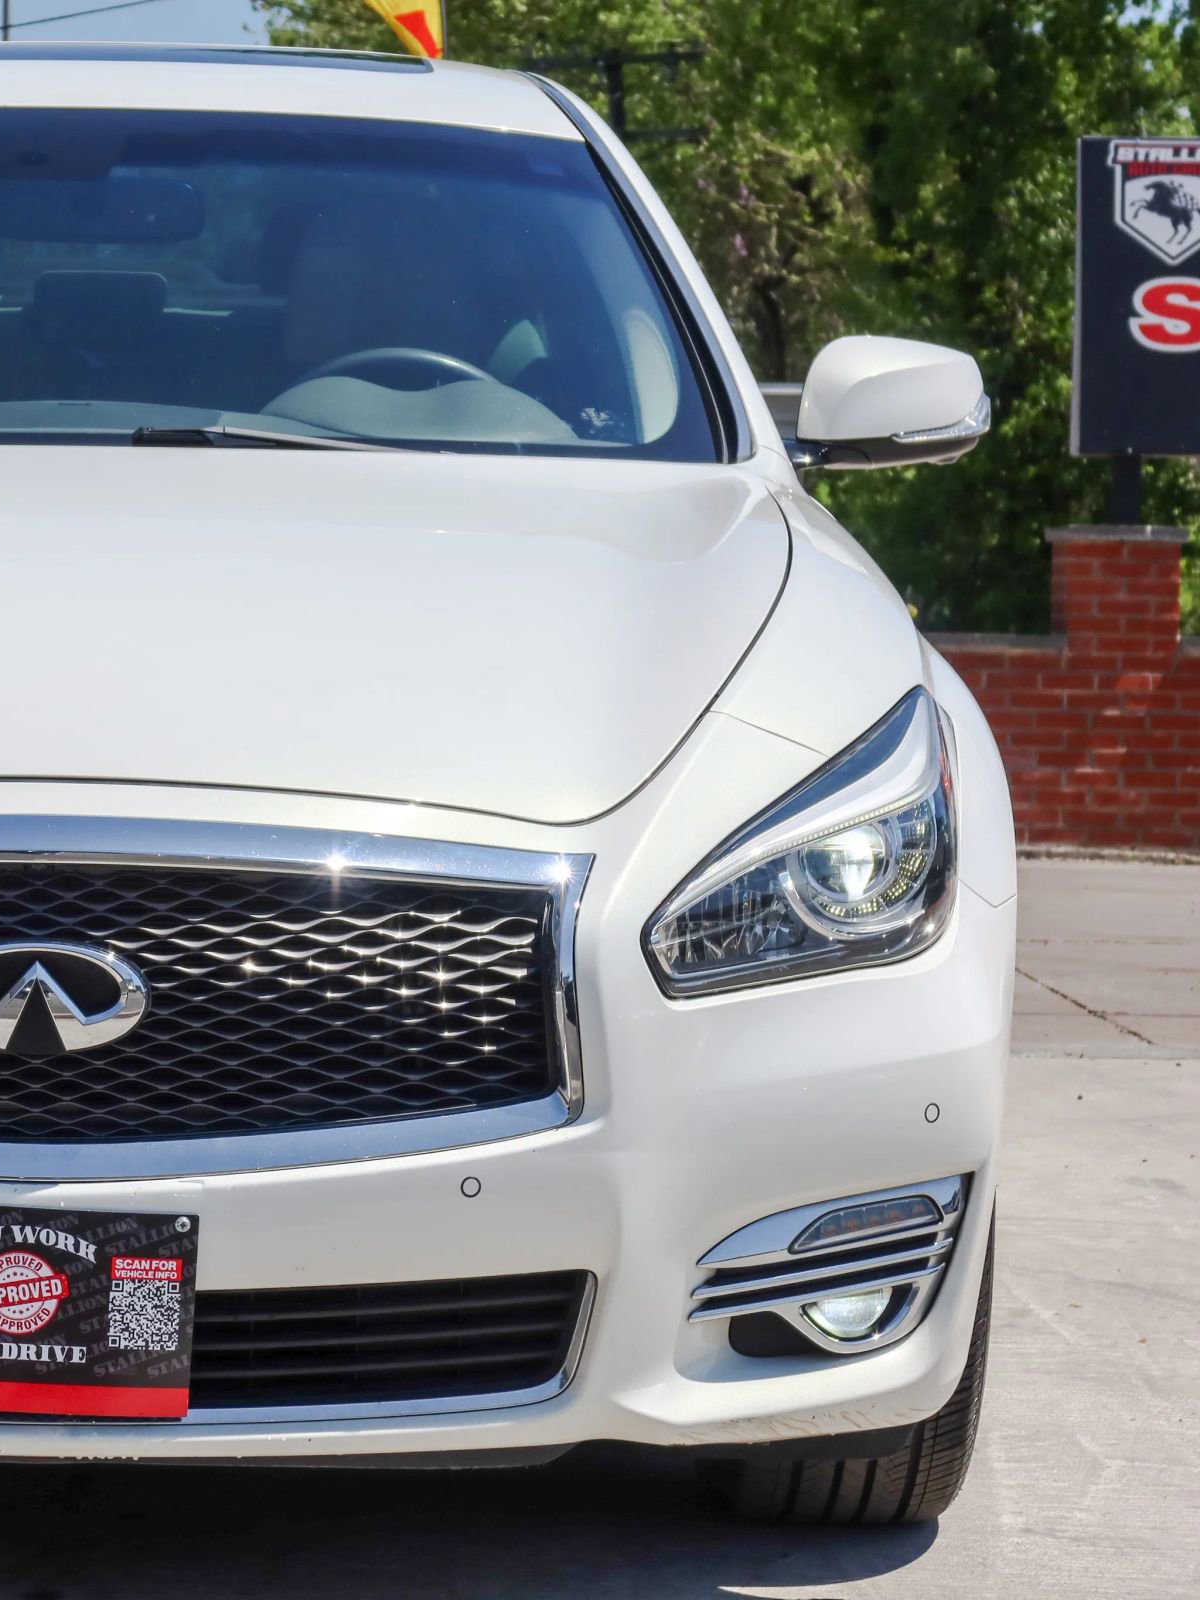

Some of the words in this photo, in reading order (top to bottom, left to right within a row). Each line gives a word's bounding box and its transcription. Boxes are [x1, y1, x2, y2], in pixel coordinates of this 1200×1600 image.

[11, 1225, 97, 1264] WORK
[115, 1259, 150, 1270] SCAN
[152, 1260, 176, 1271] FOR
[115, 1270, 154, 1279] VEHICLE
[155, 1271, 177, 1279] INFO
[0, 1342, 87, 1364] DRIVE
